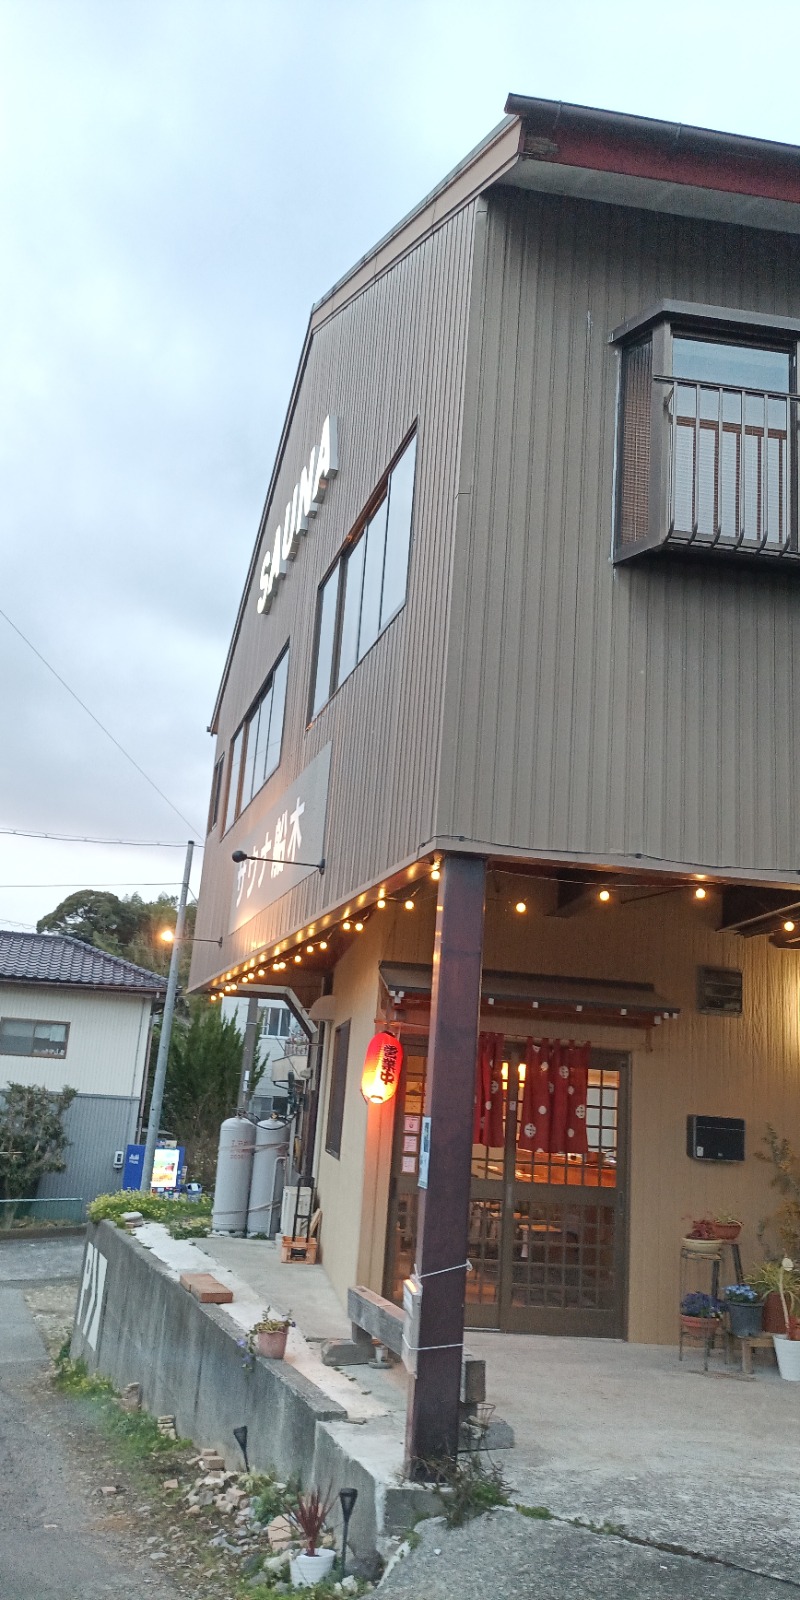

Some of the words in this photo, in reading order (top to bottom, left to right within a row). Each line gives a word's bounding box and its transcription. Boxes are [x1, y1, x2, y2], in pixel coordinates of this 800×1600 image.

[257, 414, 336, 614] SAUNA
[236, 797, 305, 907] サウナ船木
